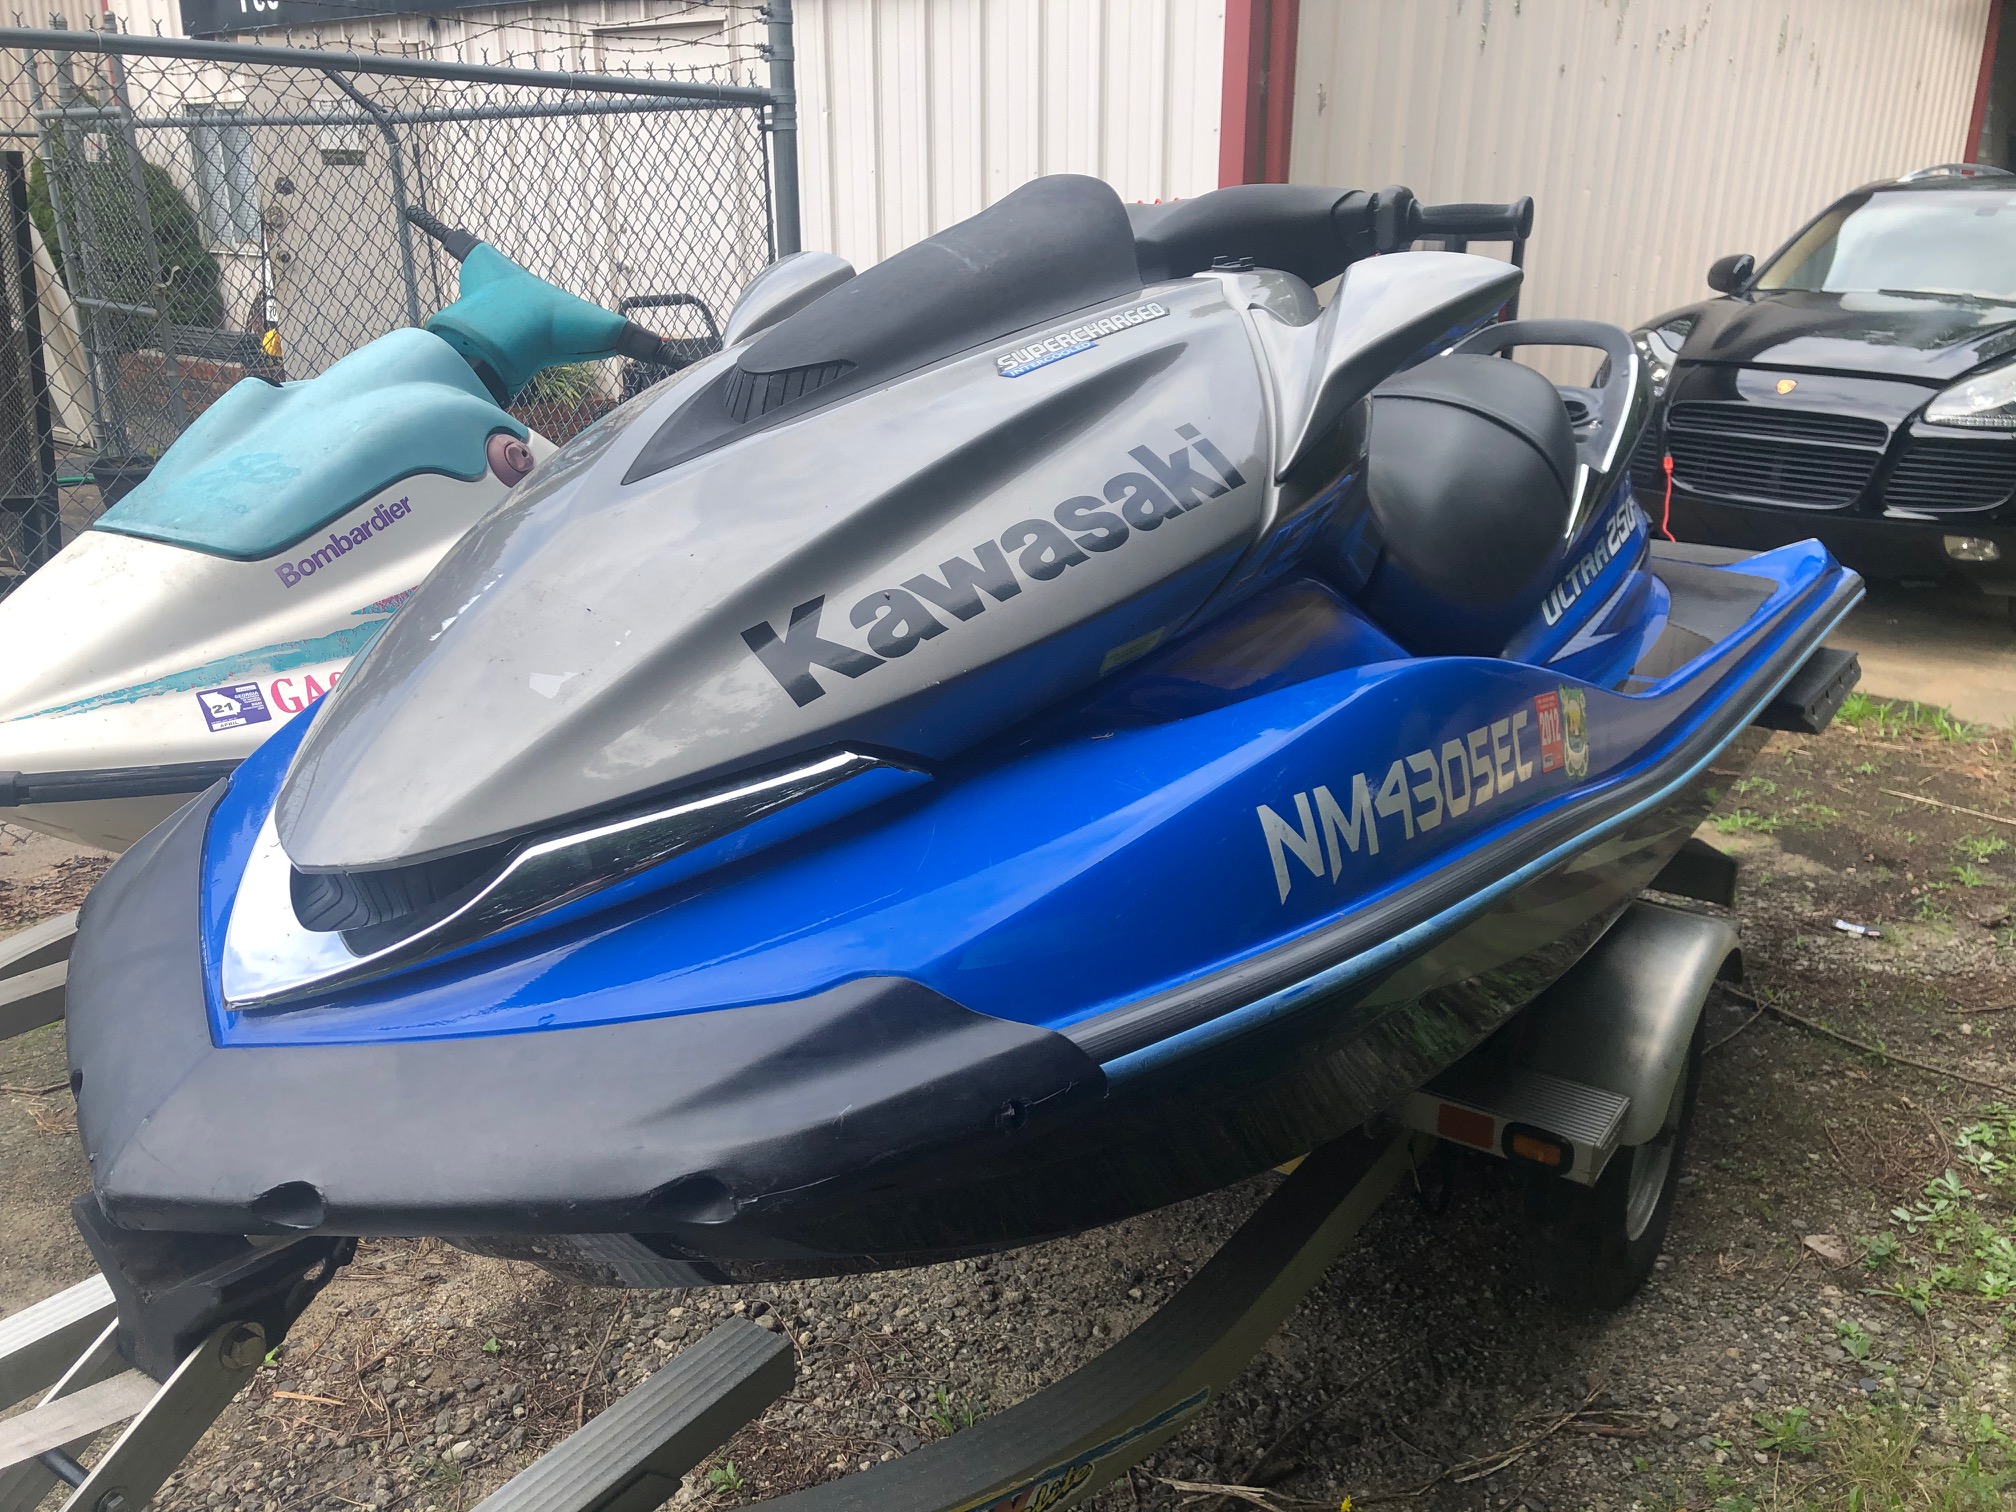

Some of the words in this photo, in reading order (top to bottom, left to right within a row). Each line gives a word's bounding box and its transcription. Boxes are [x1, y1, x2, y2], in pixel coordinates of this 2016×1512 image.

[996, 302, 1167, 371] SUPERCHARGED
[1009, 341, 1092, 376] INTERCOOLED
[274, 494, 413, 589] Bombardier
[740, 422, 1247, 708] Kawasaki
[1541, 537, 1610, 626] ULTRA
[211, 702, 234, 715] 21
[234, 690, 260, 699] GEORGIA
[1539, 707, 1562, 747] 2012
[1021, 1462, 1093, 1512] lite
